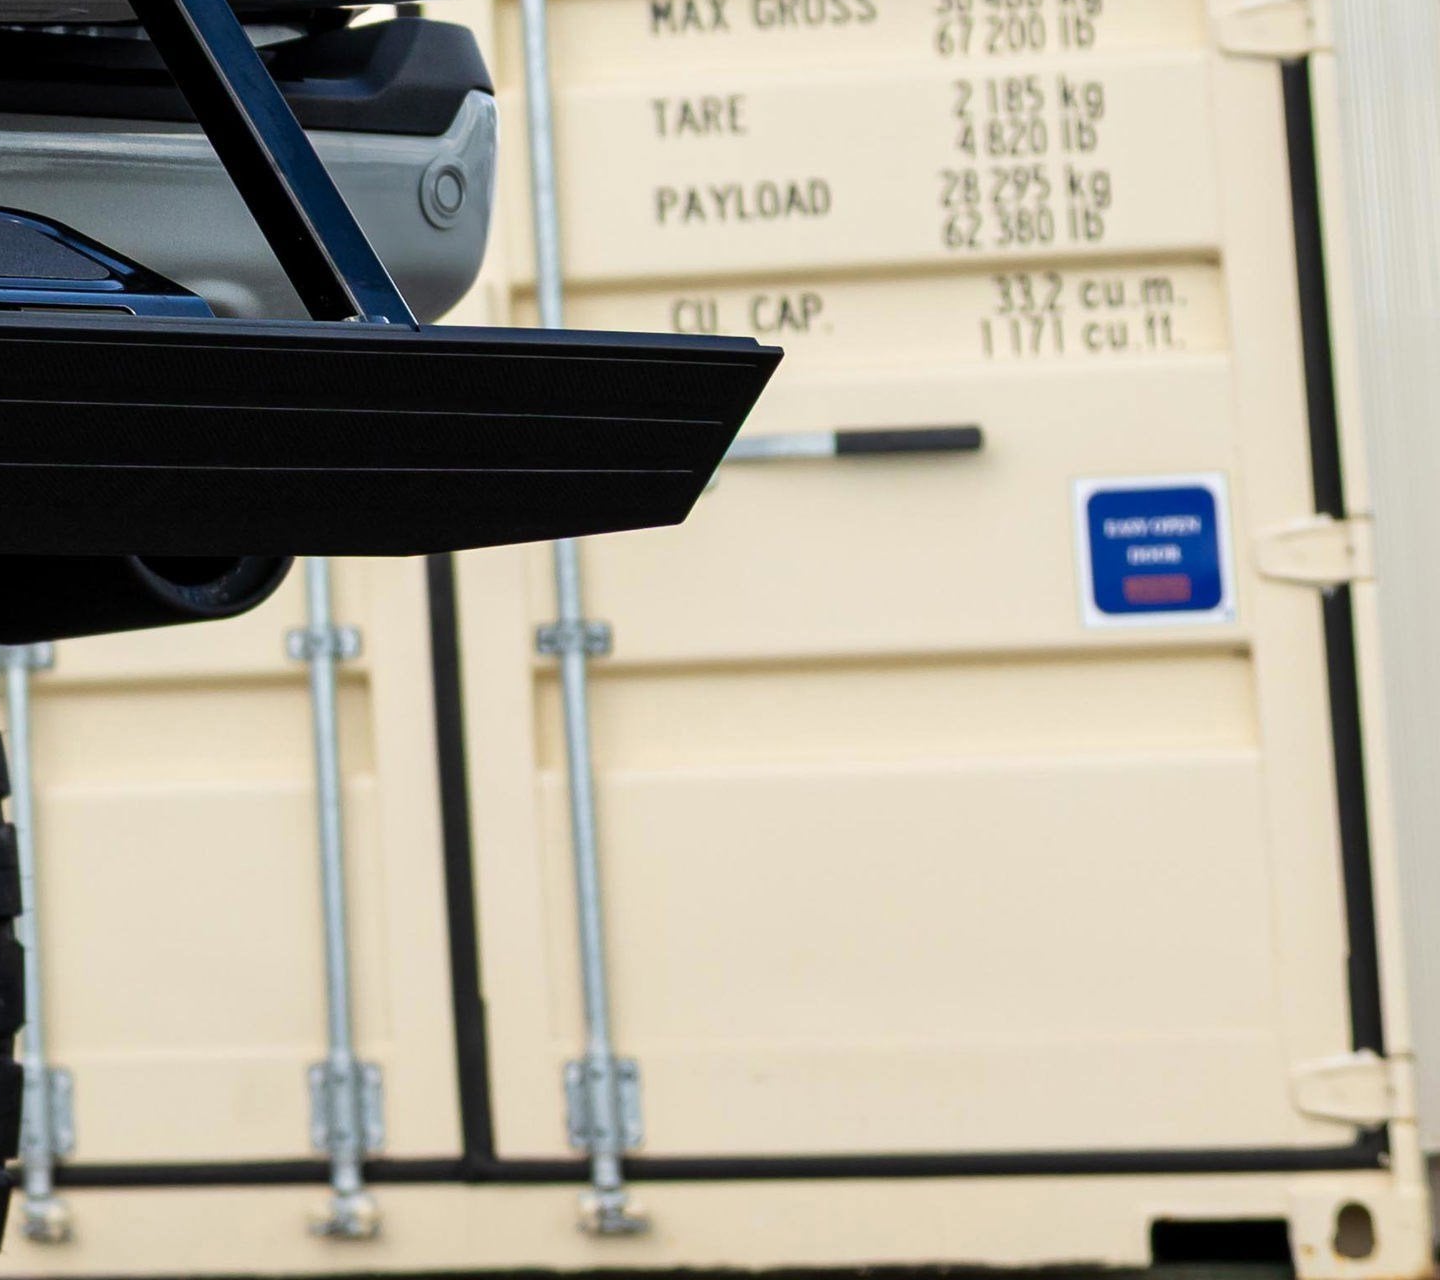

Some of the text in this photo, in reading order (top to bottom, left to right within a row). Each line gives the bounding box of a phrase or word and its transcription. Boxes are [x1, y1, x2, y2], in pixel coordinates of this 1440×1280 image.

[1059, 12, 1096, 50] lb
[650, 93, 747, 137] TARE
[1057, 72, 1105, 120] kg
[1062, 116, 1098, 153] lb
[655, 177, 831, 225] PAYLOAD
[1066, 164, 1112, 210] kg
[1068, 204, 1105, 242] lb
